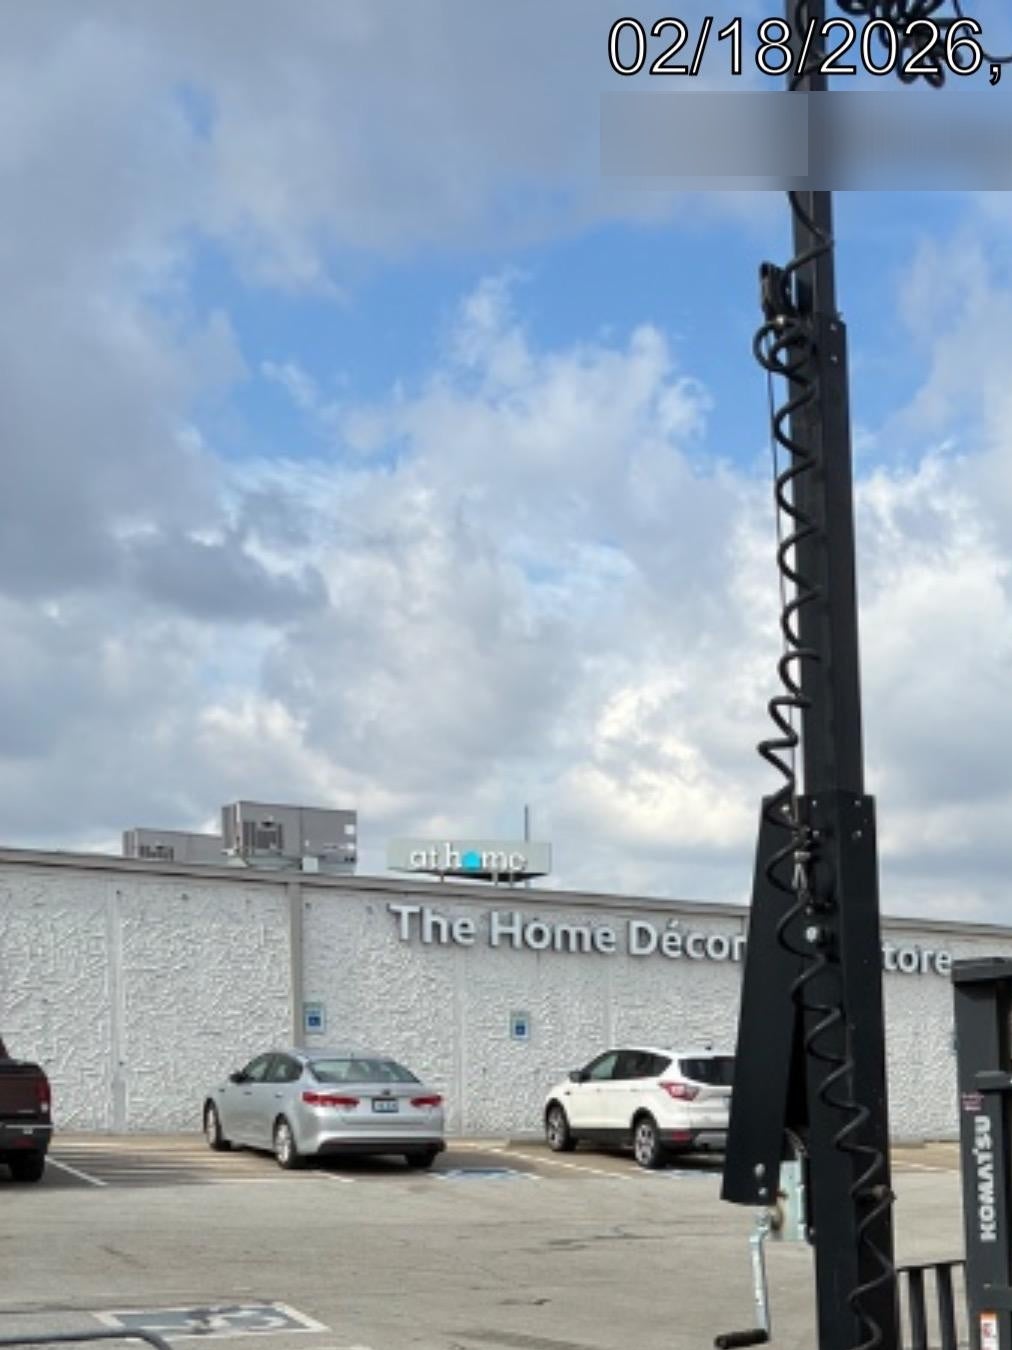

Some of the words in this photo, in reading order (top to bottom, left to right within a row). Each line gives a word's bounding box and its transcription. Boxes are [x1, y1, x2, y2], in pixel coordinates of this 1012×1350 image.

[388, 903, 475, 946] The
[488, 910, 616, 952] Home
[627, 918, 747, 962] Décor
[882, 943, 952, 976] tore
[972, 1115, 997, 1243] KOMATSU
